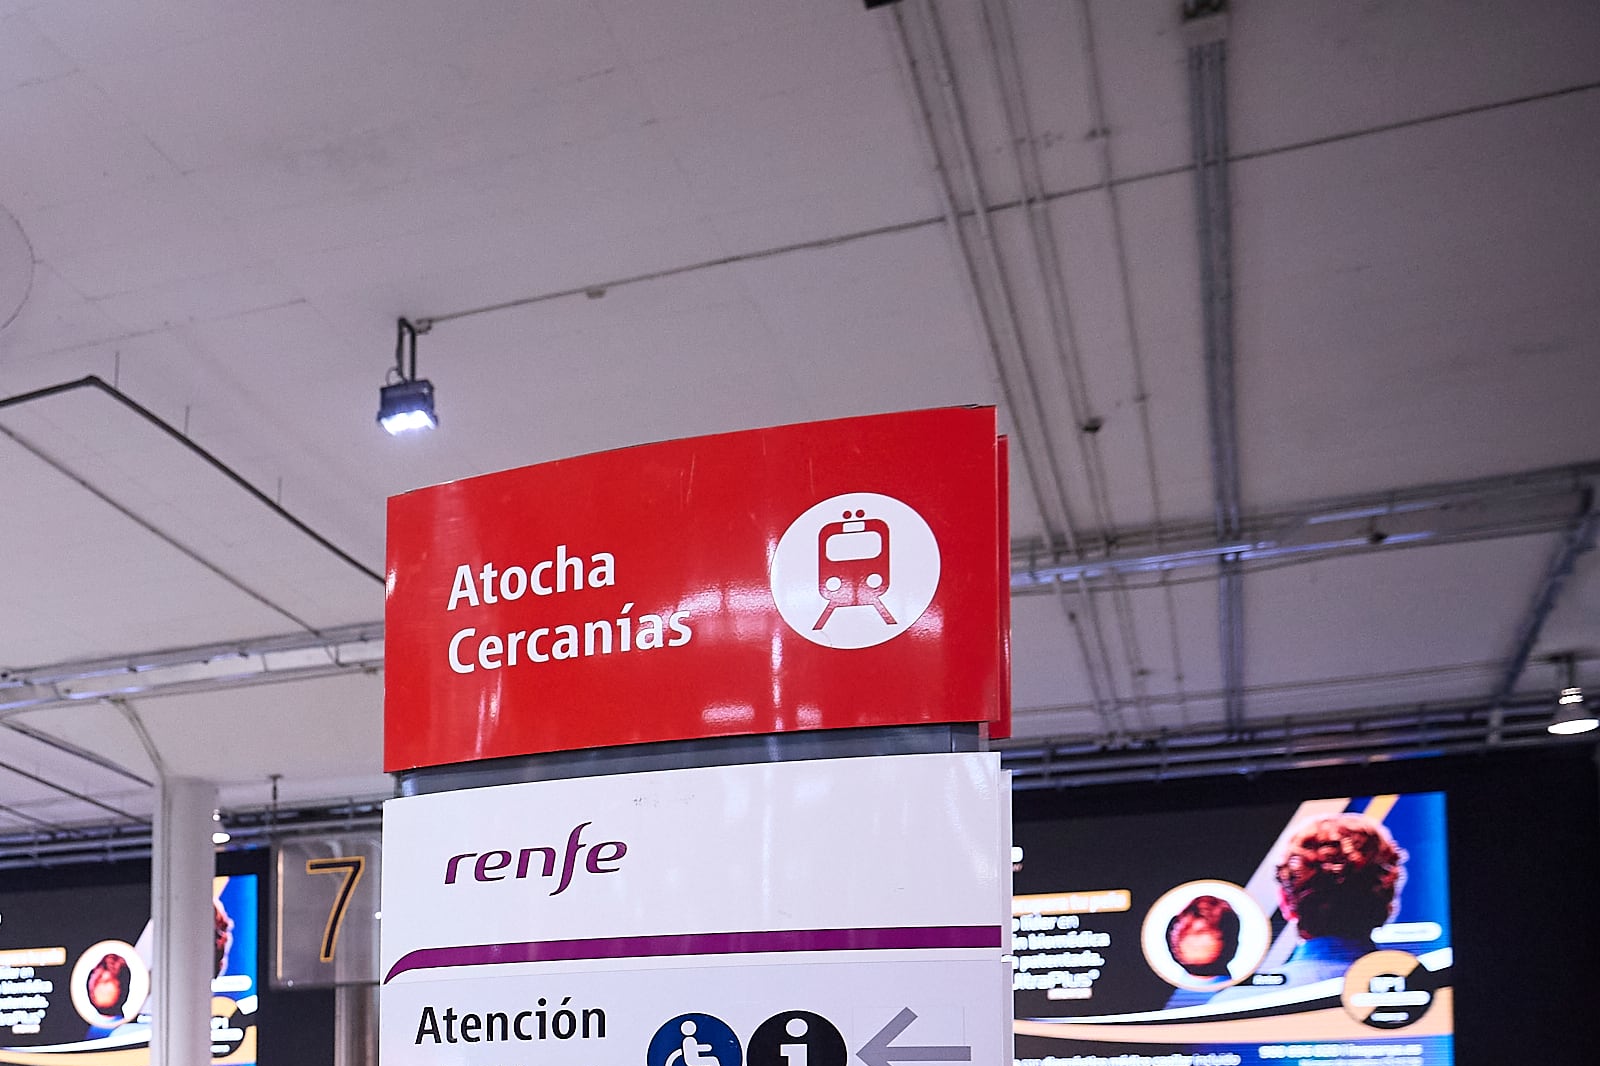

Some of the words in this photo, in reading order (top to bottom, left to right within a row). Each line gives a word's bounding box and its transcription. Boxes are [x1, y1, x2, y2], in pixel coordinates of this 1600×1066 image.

[447, 544, 616, 611] Atocha
[448, 602, 693, 674] Cercanías
[444, 821, 628, 897] renfe
[306, 856, 366, 963] 7
[414, 996, 607, 1045] Atención
